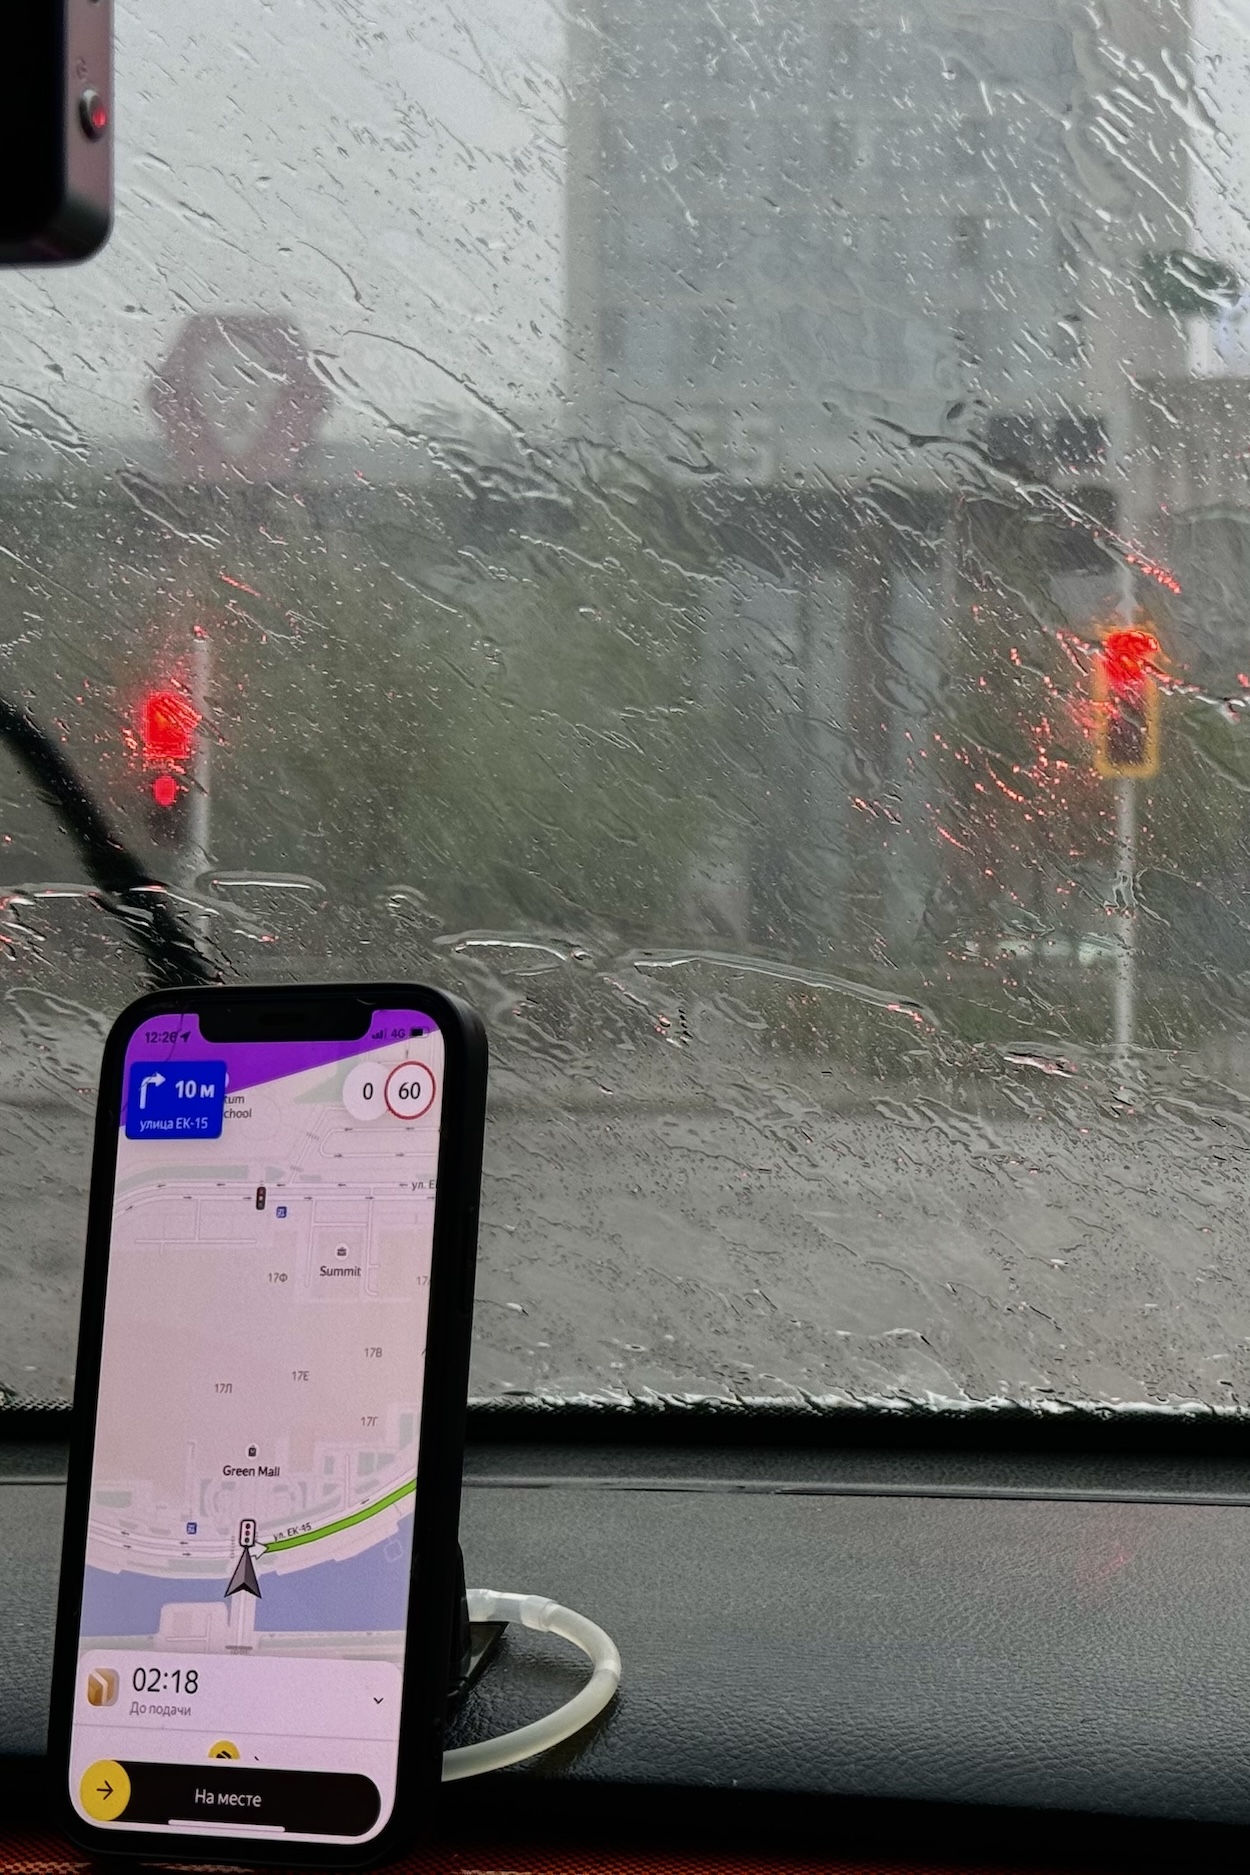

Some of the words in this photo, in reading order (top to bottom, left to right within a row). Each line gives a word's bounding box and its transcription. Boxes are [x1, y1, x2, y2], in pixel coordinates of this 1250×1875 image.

[145, 1031, 178, 1043] 12:26
[390, 1027, 406, 1039] 4G
[175, 1080, 197, 1098] 10
[362, 1082, 374, 1100] 0
[398, 1081, 421, 1100] 60
[139, 1119, 174, 1132] улица
[319, 1266, 362, 1279] Summit
[416, 1275, 431, 1286] 17
[222, 1465, 256, 1477] Green
[257, 1466, 281, 1477] Mall
[132, 1667, 199, 1694] 02:18
[129, 1702, 147, 1716] До
[148, 1704, 192, 1718] подачи
[194, 1788, 215, 1805] На
[217, 1793, 263, 1808] месте
